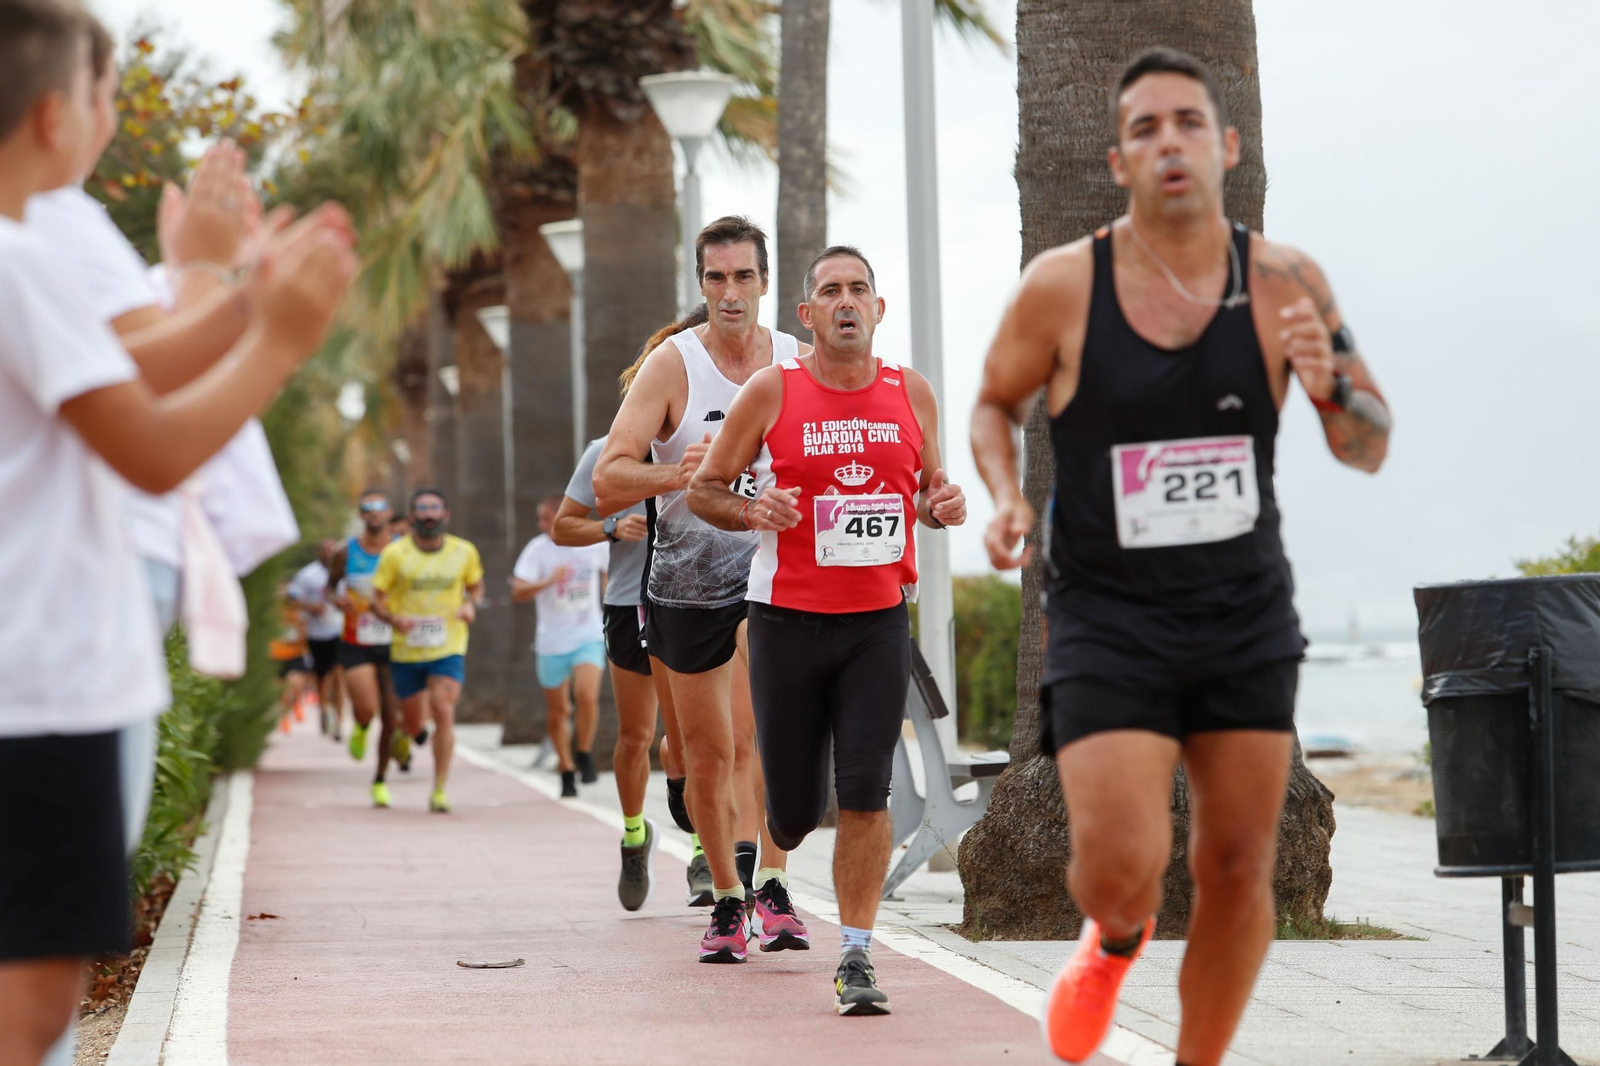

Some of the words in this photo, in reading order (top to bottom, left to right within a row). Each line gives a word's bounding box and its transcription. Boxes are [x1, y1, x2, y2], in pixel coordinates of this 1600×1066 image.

[803, 422, 816, 434] 21
[822, 417, 867, 432] EDICIÓN
[868, 422, 899, 431] CARRERA
[803, 430, 863, 446] GUARDIA
[867, 430, 901, 443] CIVIL
[804, 444, 834, 457] PILAR
[838, 443, 864, 454] 2018
[1164, 469, 1243, 502] 221
[845, 516, 899, 538] 467
